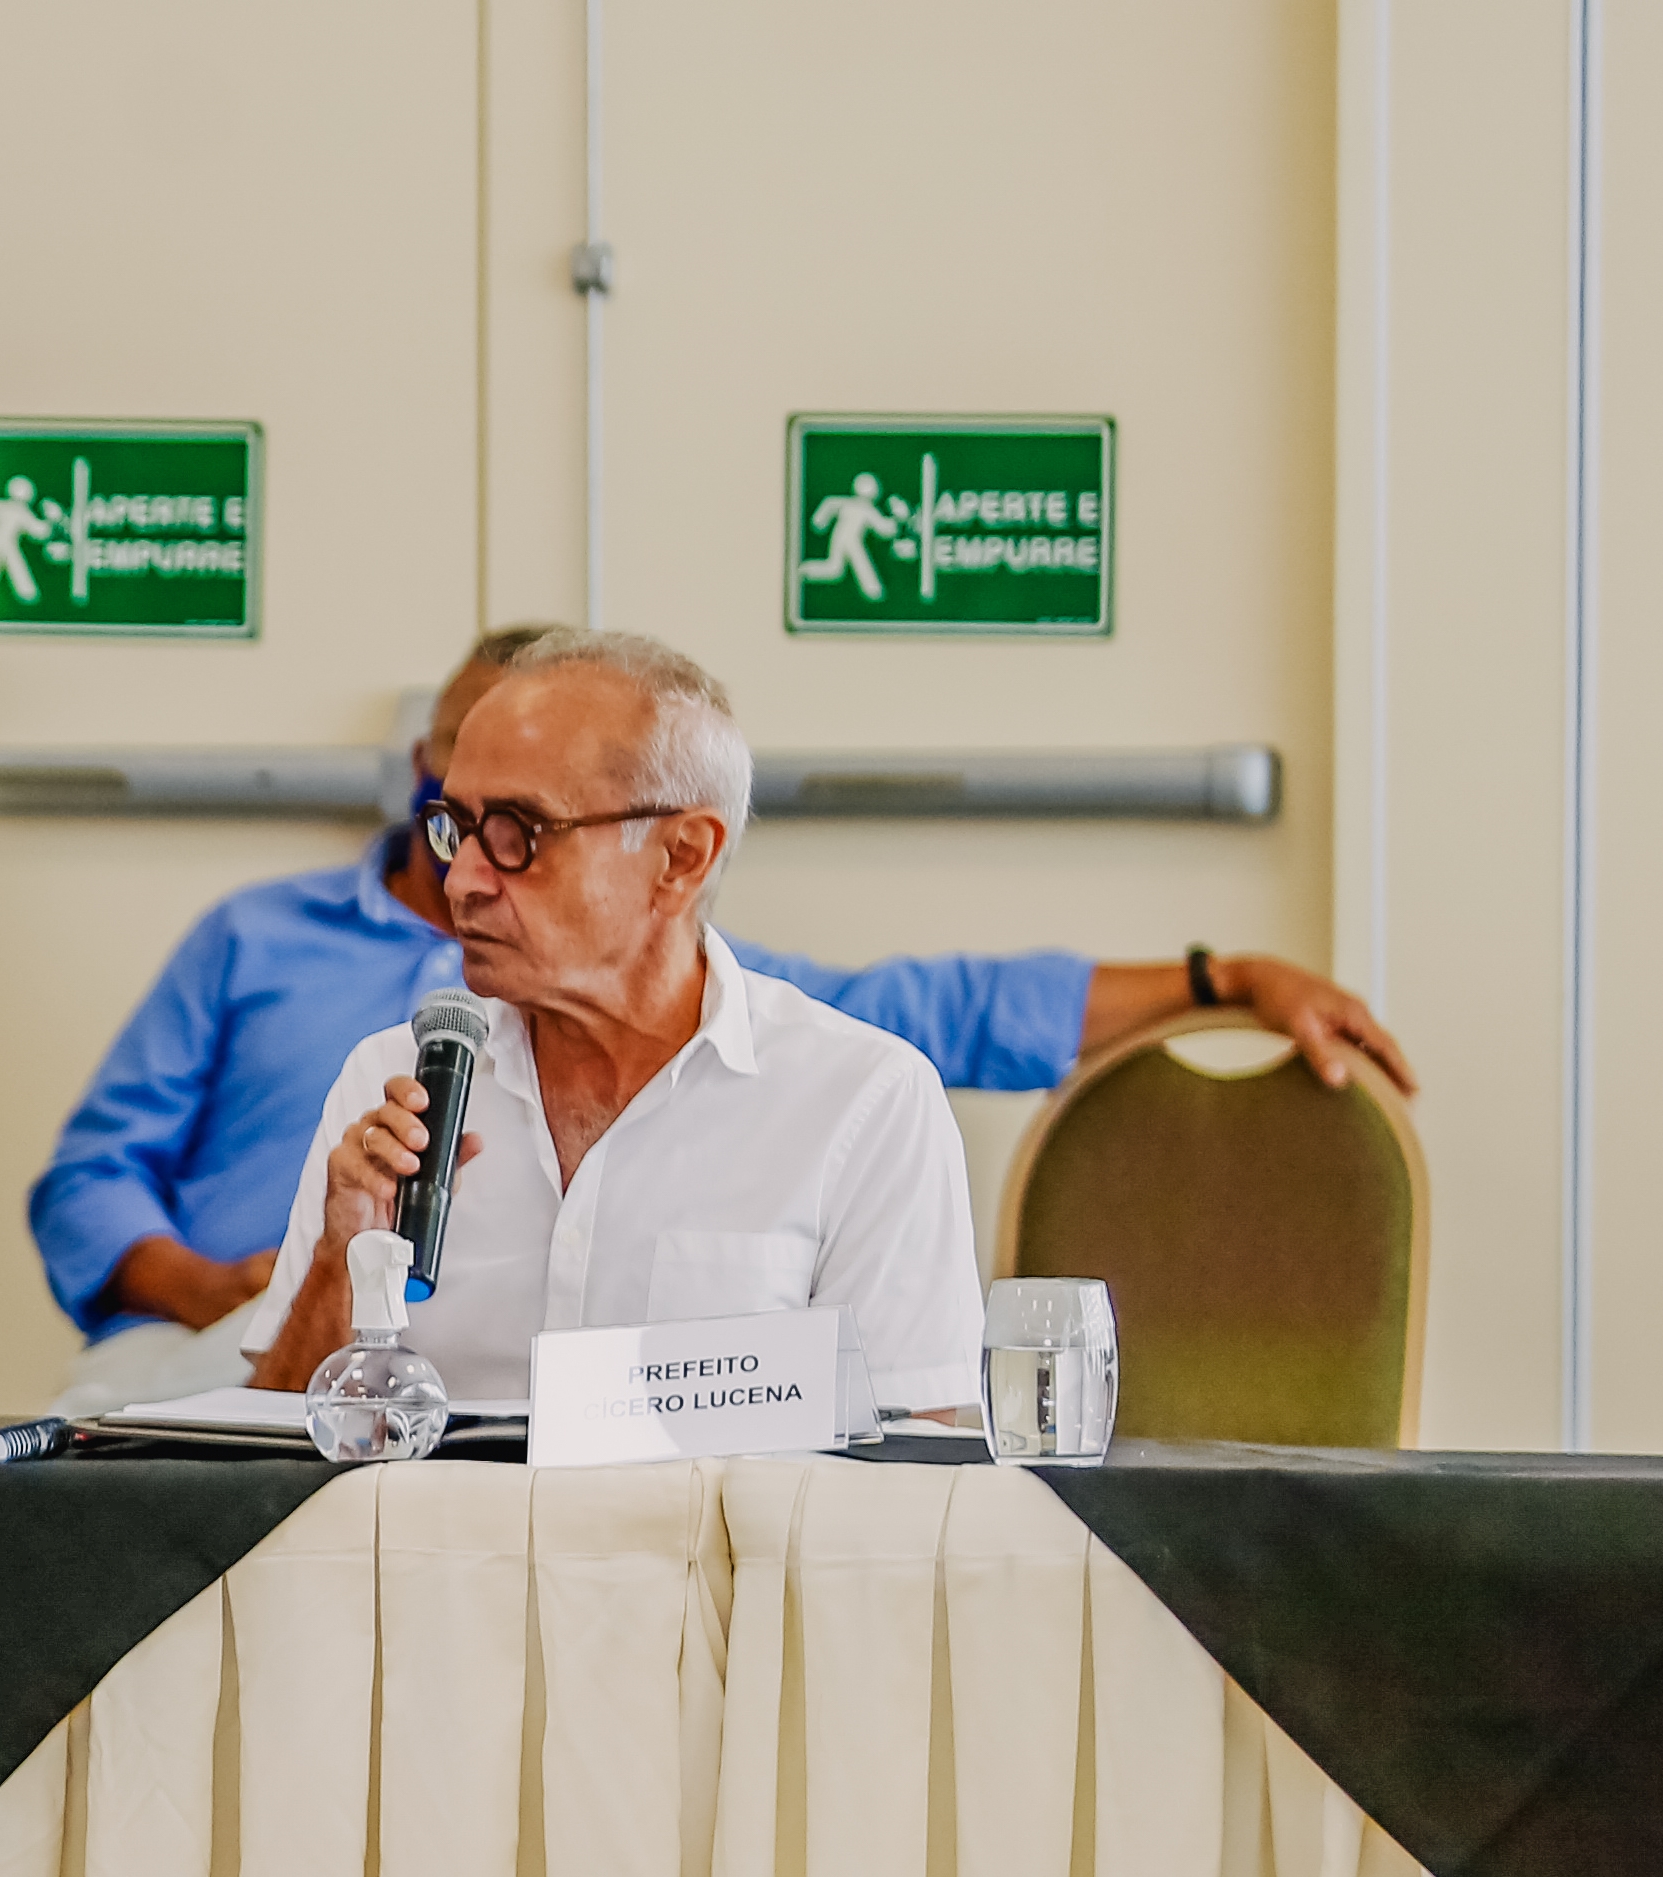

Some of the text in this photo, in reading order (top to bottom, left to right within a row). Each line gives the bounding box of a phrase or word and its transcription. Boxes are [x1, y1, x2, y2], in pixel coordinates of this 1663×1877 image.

[1078, 491, 1098, 526] E
[629, 1355, 759, 1382] PREFEITO
[693, 1383, 803, 1410] LUCENA
